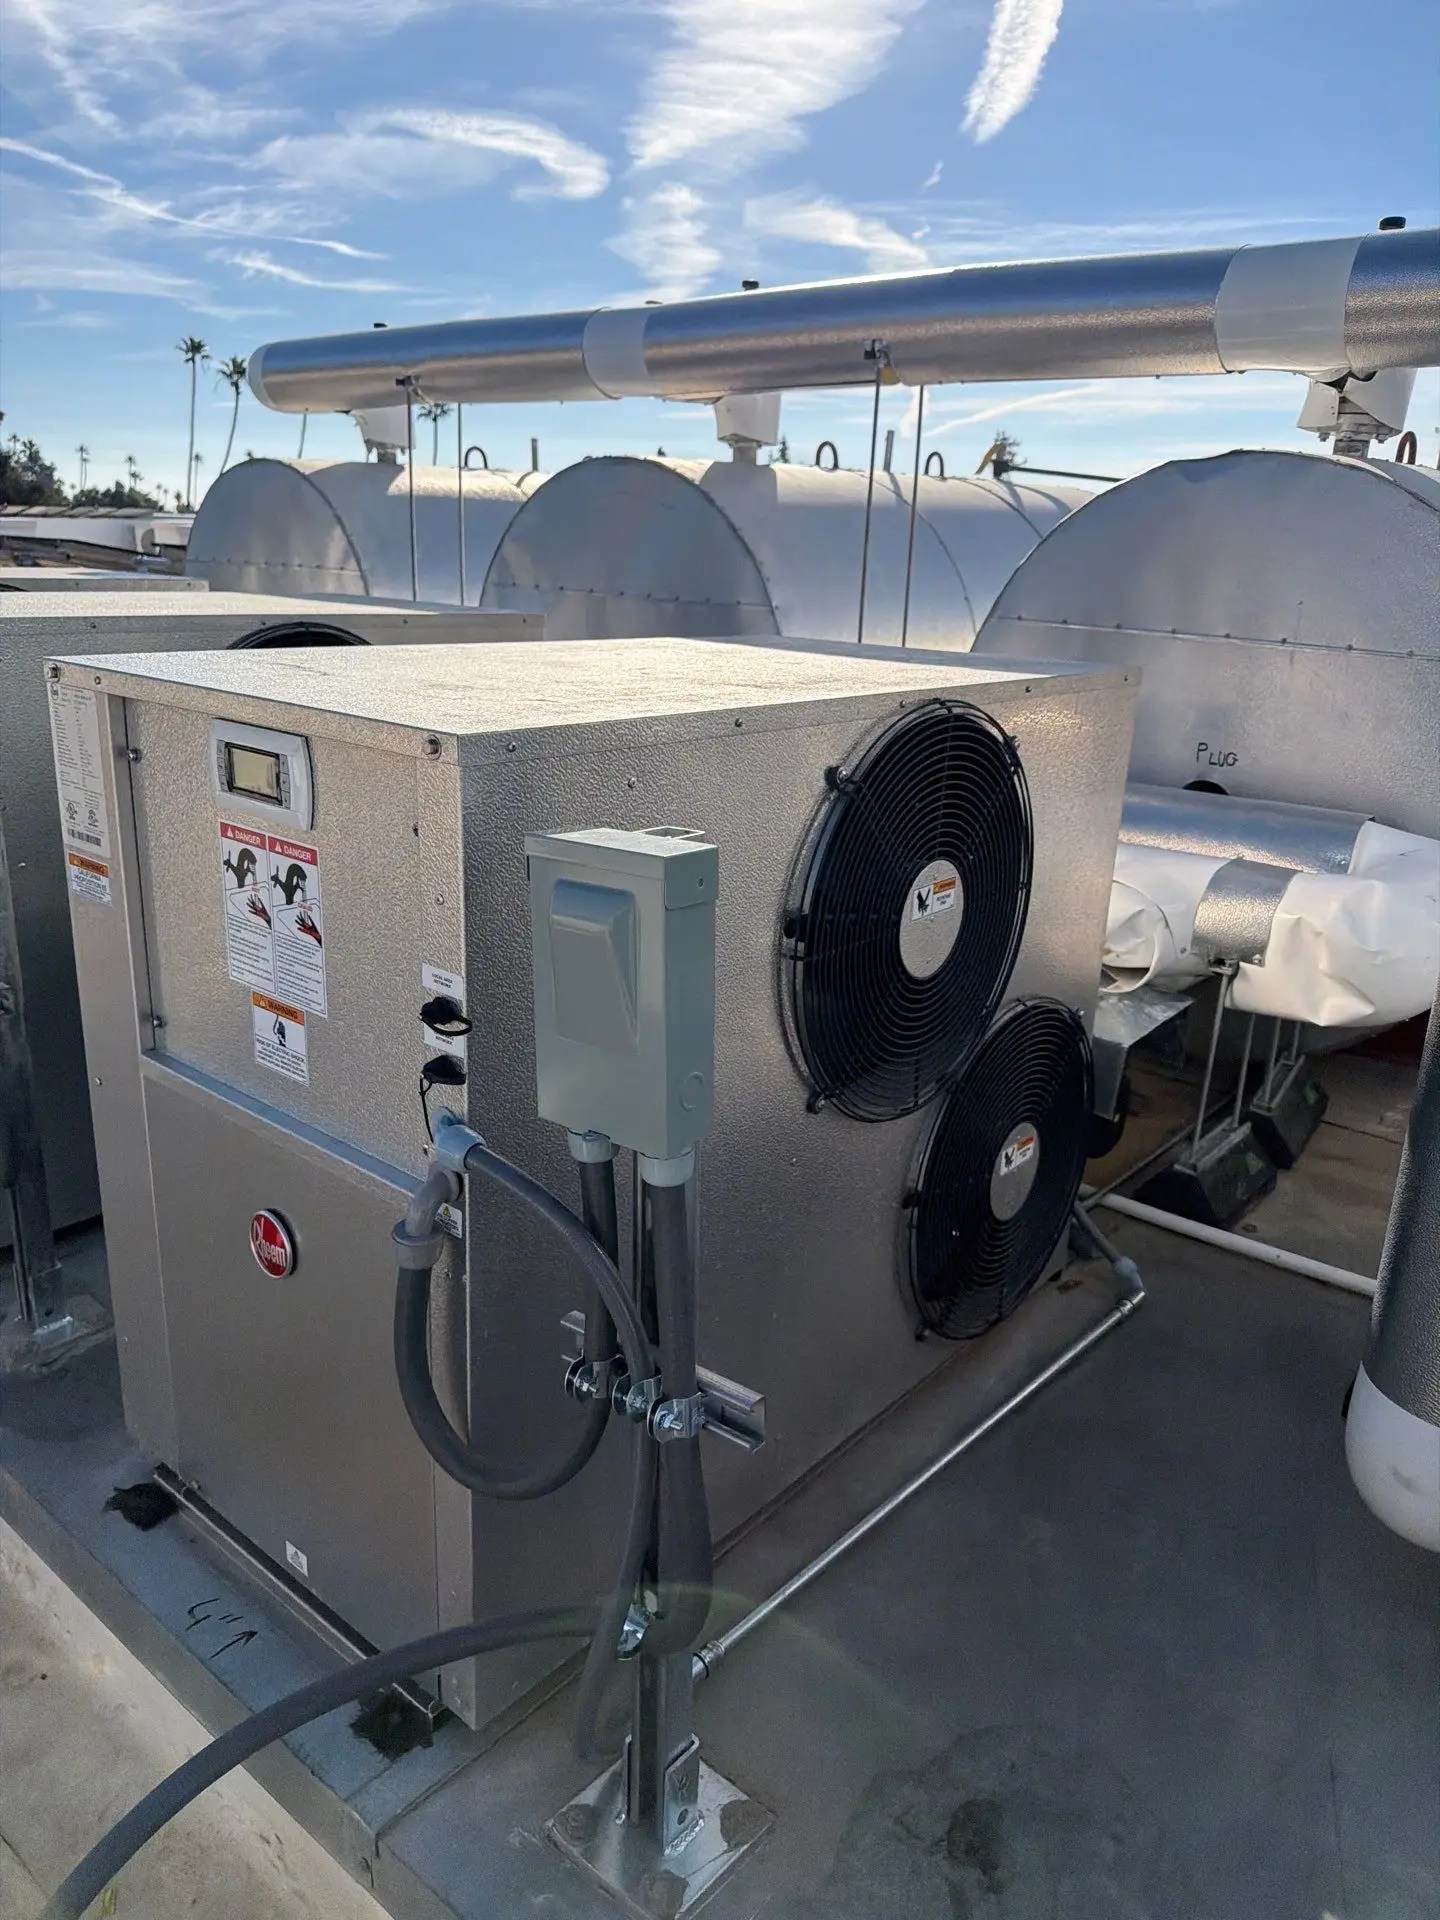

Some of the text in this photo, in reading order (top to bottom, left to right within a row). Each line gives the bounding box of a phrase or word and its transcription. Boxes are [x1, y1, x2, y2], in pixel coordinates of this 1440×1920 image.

[1196, 742, 1239, 768] PLUG
[235, 830, 261, 845] DANGER
[283, 845, 312, 861] DANGER
[268, 1002, 298, 1020] WARNING
[253, 1217, 286, 1268] Rheem
